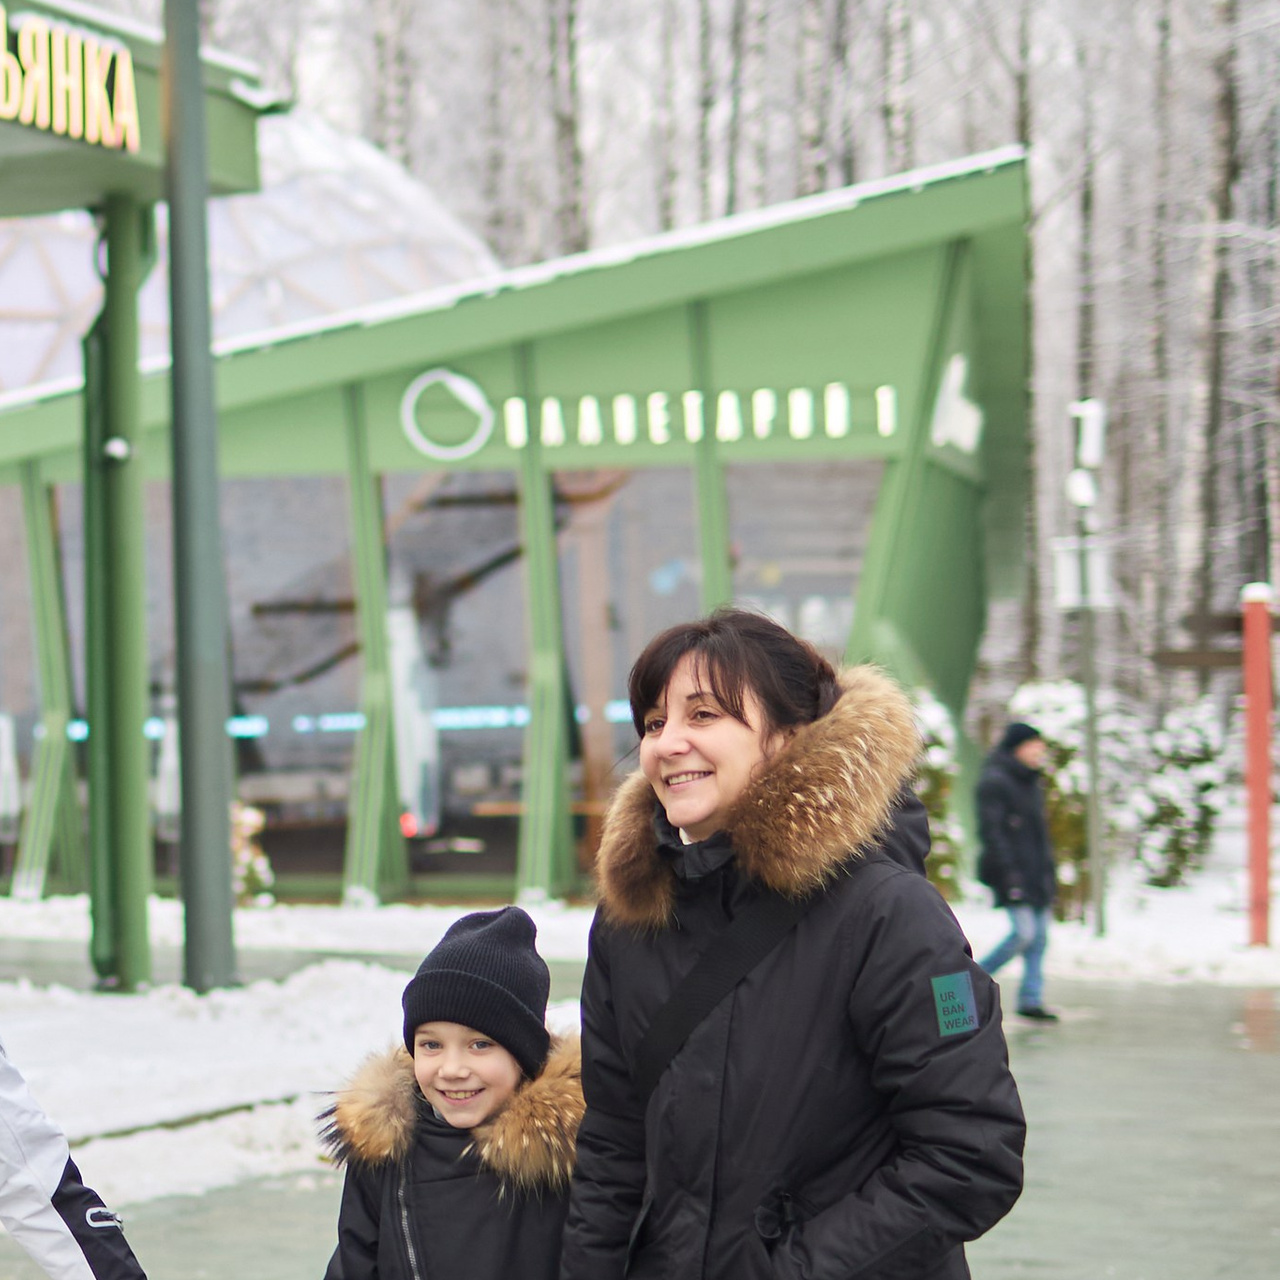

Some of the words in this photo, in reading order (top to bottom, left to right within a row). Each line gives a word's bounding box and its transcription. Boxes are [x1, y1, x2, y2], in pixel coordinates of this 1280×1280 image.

[939, 991, 956, 1002] UR
[942, 1004, 965, 1016] BAN
[944, 1016, 975, 1030] WEAR
